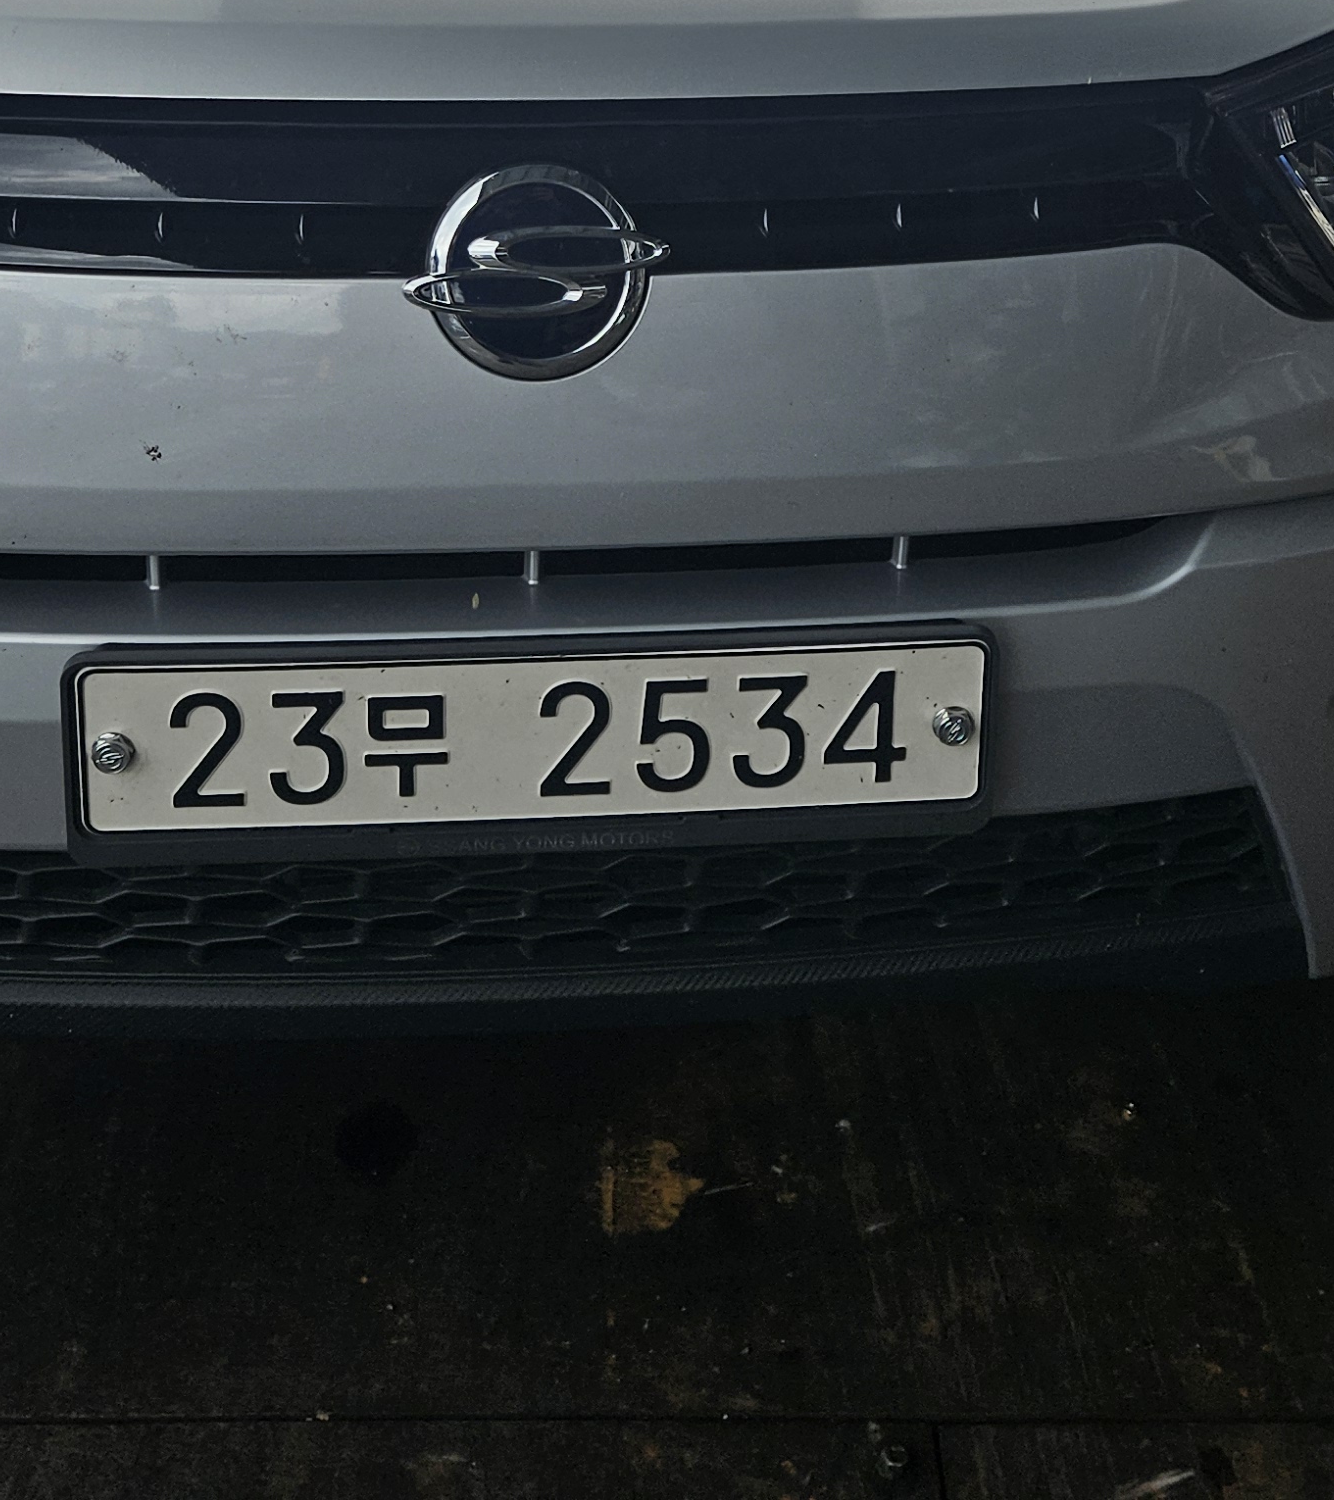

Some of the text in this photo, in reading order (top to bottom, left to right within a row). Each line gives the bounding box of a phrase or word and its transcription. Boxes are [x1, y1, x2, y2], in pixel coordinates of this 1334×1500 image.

[169, 670, 907, 808] 23무 2534
[513, 832, 576, 851] YONG
[579, 829, 676, 849] MOTORS
